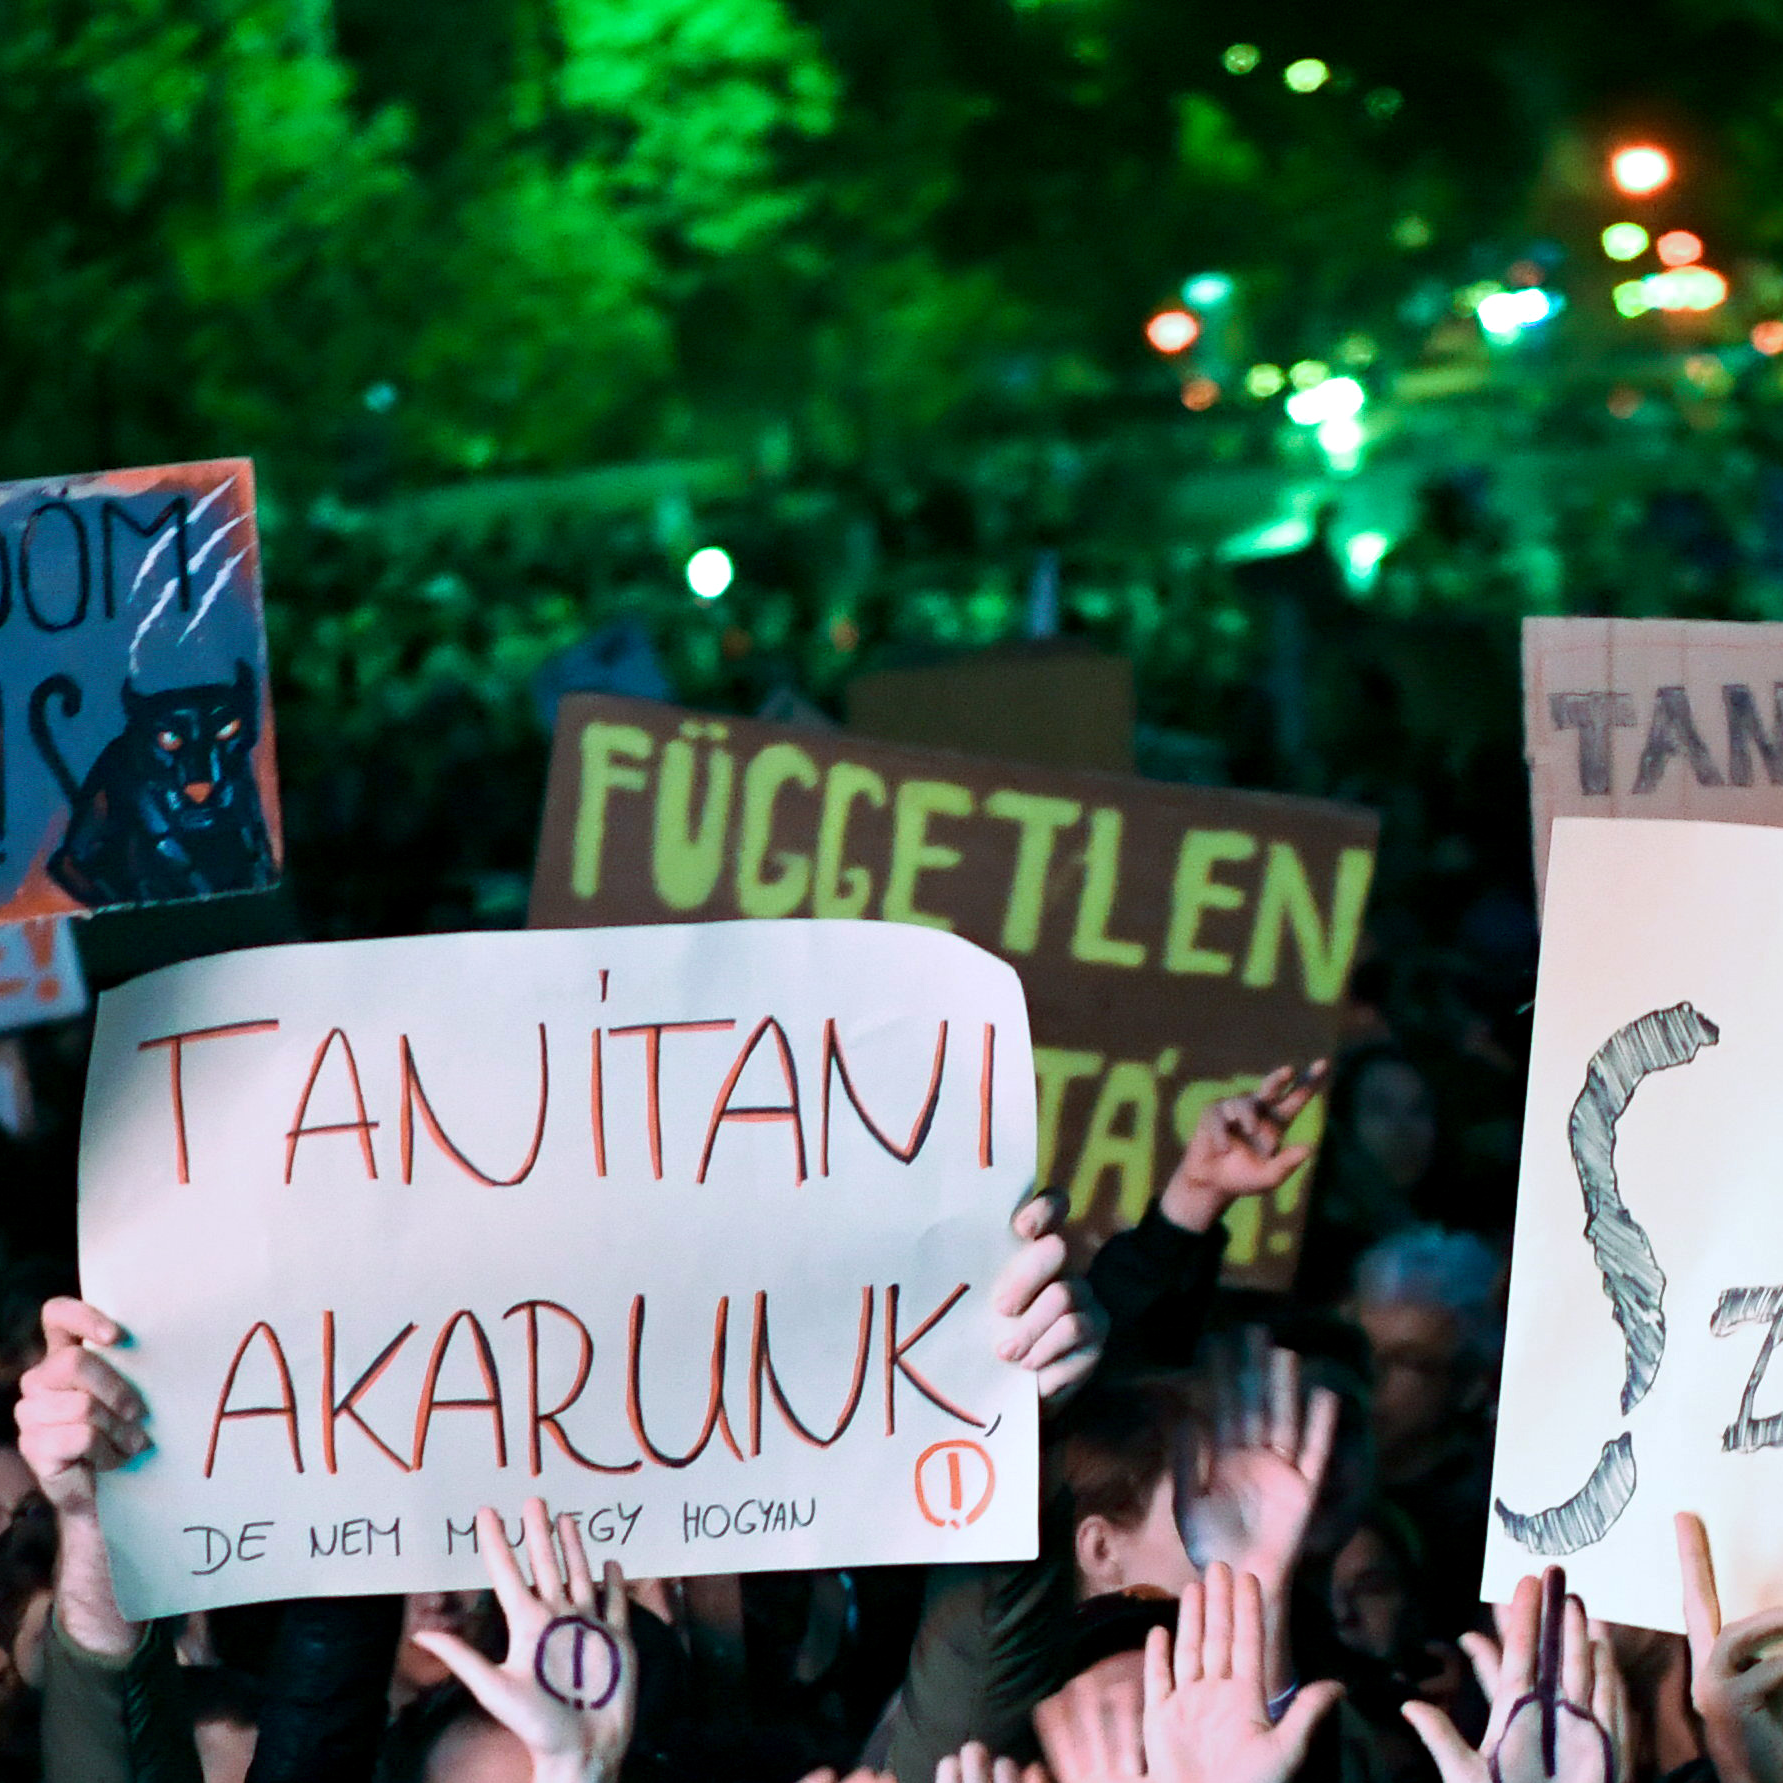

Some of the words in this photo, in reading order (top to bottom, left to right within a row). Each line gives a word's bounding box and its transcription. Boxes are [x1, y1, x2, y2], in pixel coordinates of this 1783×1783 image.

[571, 720, 1373, 1005] FÜGGETLEN
[140, 968, 994, 1186] TANÍTANI
[184, 1520, 273, 1574] DE
[310, 1504, 400, 1558] NEM
[683, 1497, 817, 1544] HOGYAN
